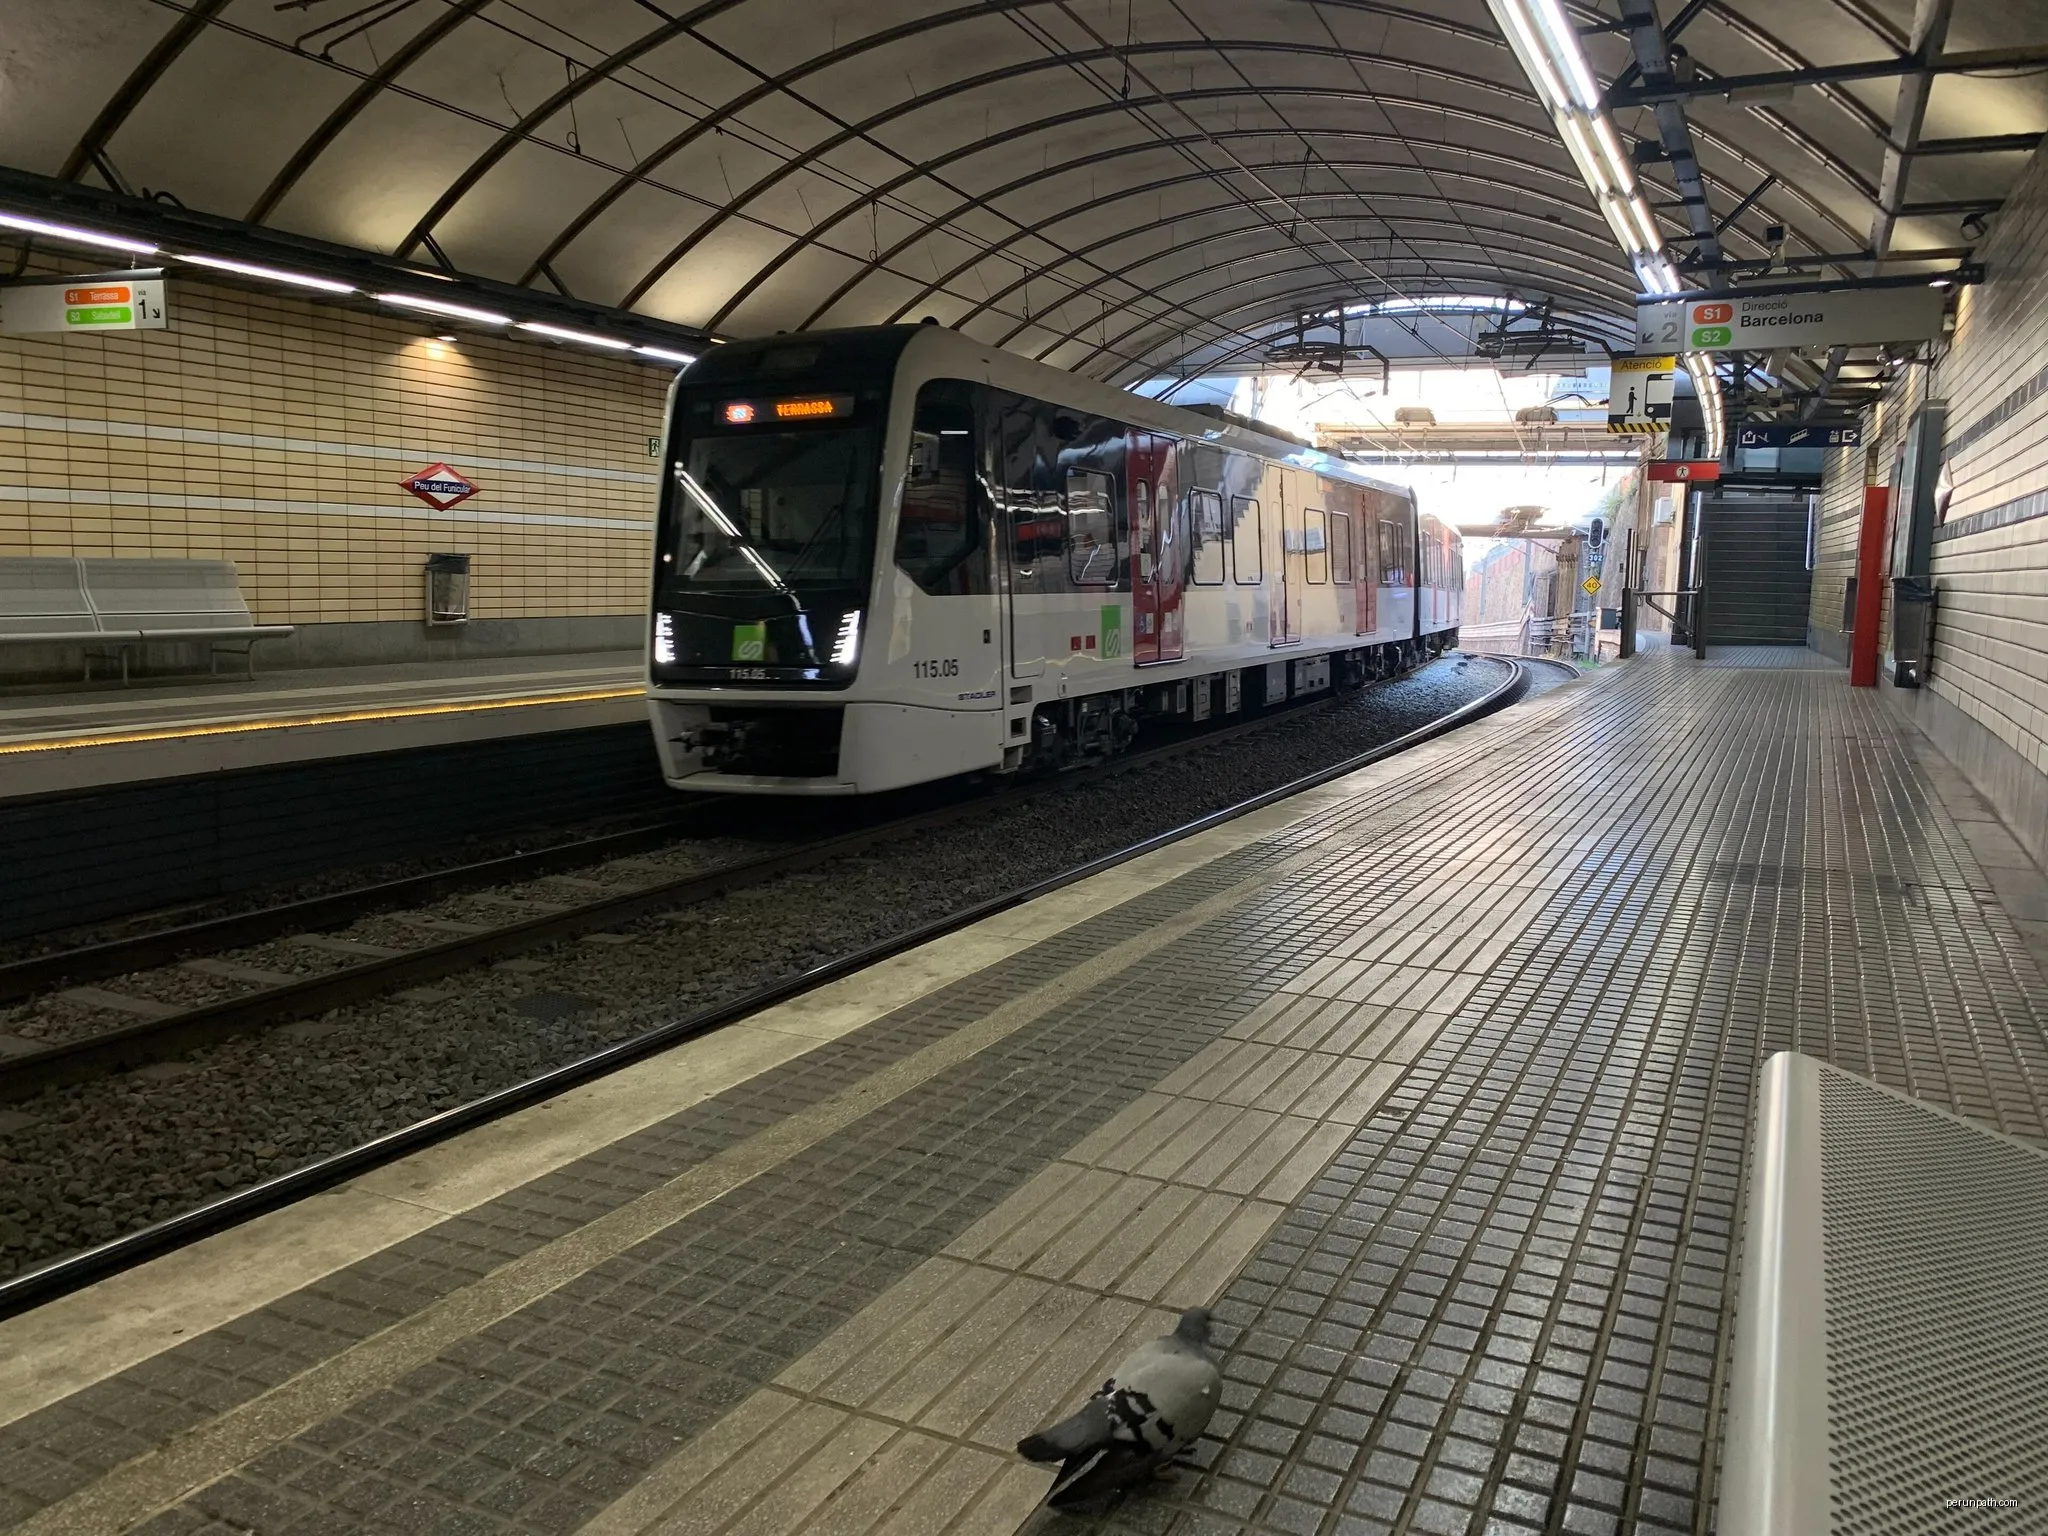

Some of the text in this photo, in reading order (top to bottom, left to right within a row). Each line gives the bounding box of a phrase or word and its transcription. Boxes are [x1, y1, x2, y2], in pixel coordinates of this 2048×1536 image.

[69, 291, 119, 302] S1 Terrassa
[138, 299, 147, 319] 1
[1704, 307, 1721, 320] S1
[1742, 301, 1788, 312] Direcció
[1740, 312, 1824, 328] Barcelona
[1661, 322, 1678, 343] 2
[1701, 330, 1721, 343] S2
[1620, 360, 1662, 370] Atenció
[776, 401, 833, 417] TERRASSA
[414, 480, 471, 494] Peu del Funicular
[913, 658, 959, 679] 115.05
